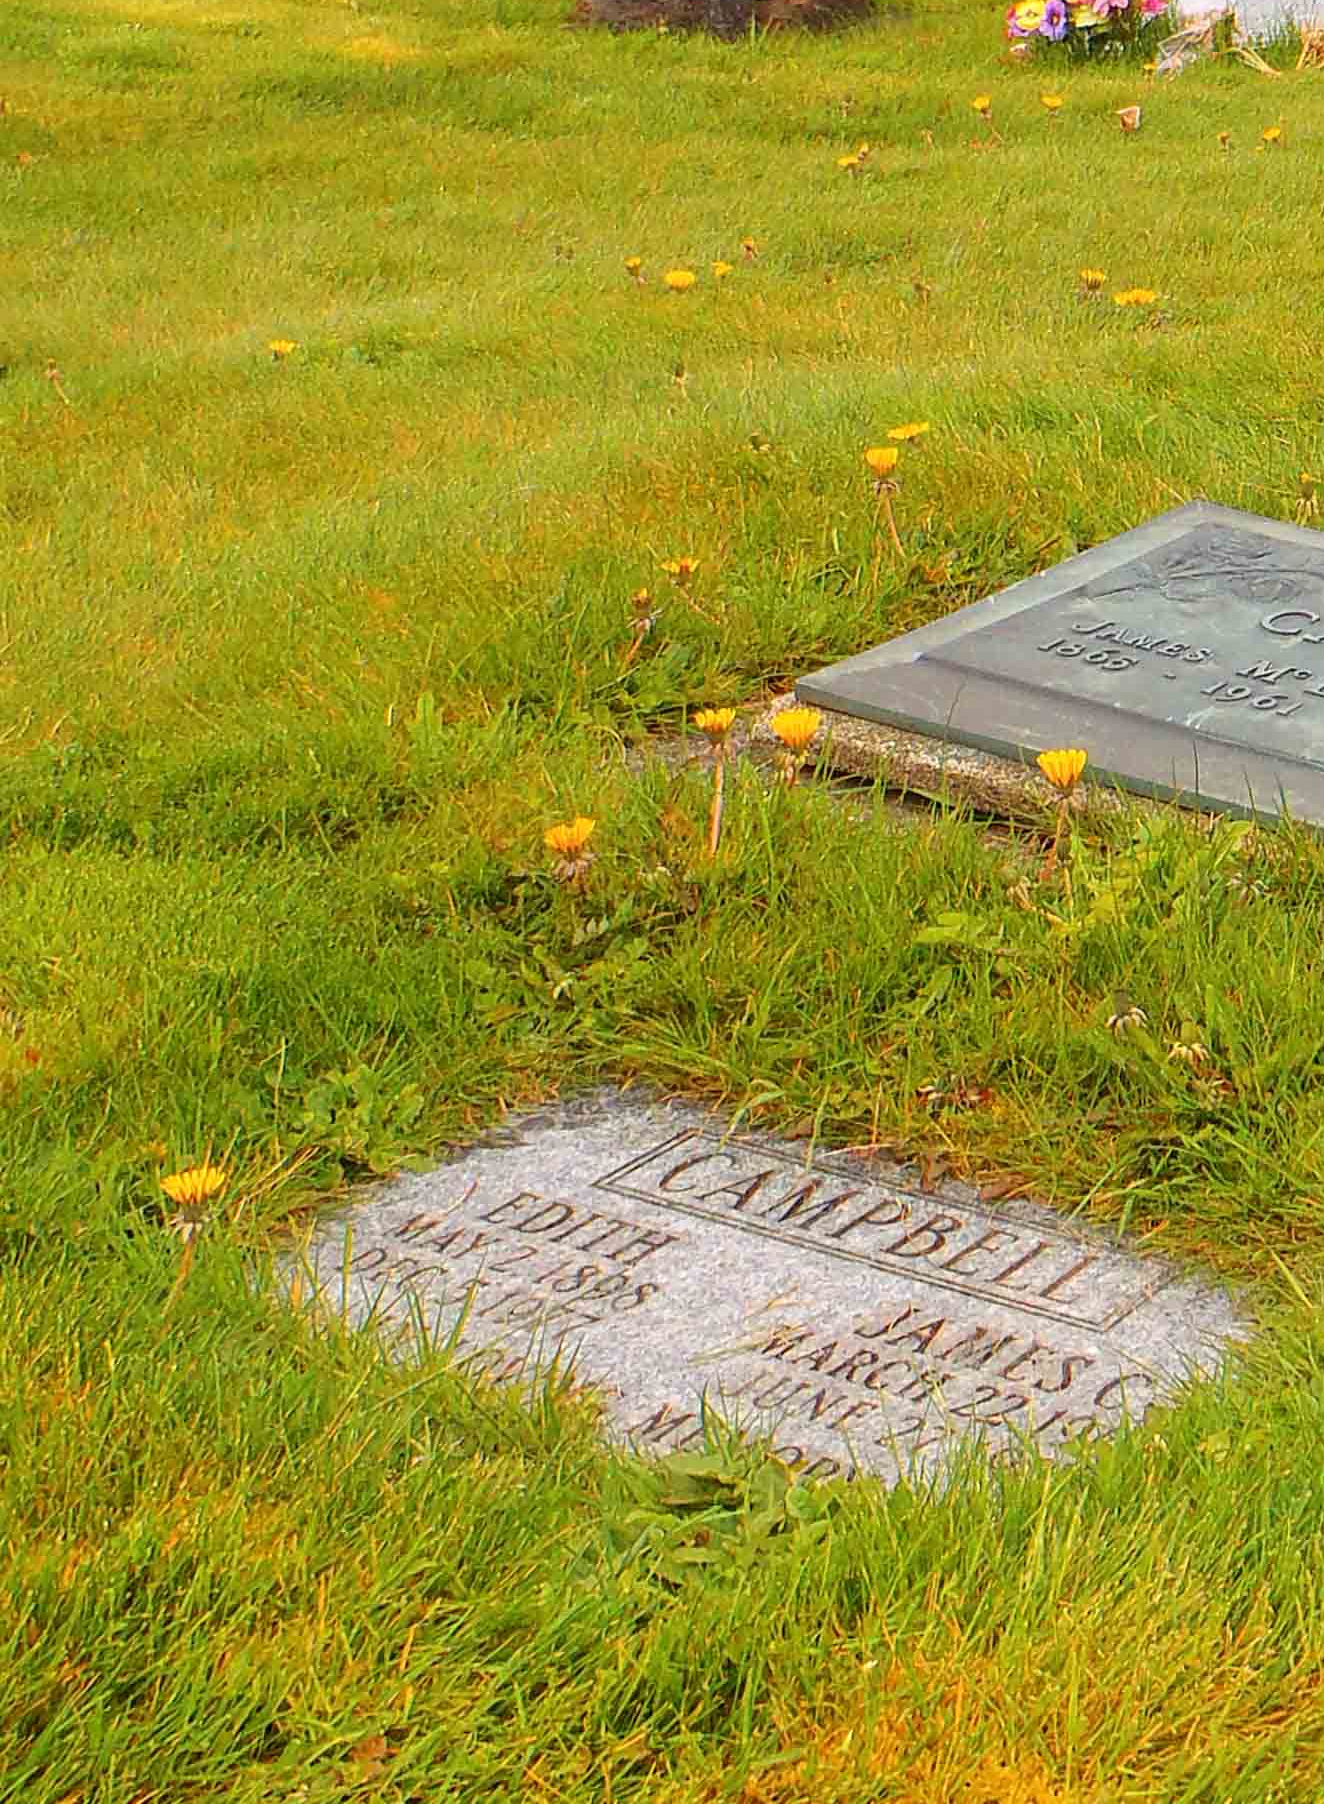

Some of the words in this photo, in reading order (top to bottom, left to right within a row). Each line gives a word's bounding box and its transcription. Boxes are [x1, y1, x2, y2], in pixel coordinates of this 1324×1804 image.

[1037, 637, 1140, 672] 1865
[1201, 680, 1304, 718] 1961
[1071, 619, 1215, 663] JAMES
[383, 1211, 502, 1260] MAY
[478, 1191, 683, 1265] EDITH
[657, 1151, 1098, 1305] CAMPBELL
[761, 1329, 956, 1402] MARCH
[853, 1303, 1096, 1394] JAMES
[722, 1372, 881, 1429] JUNE
